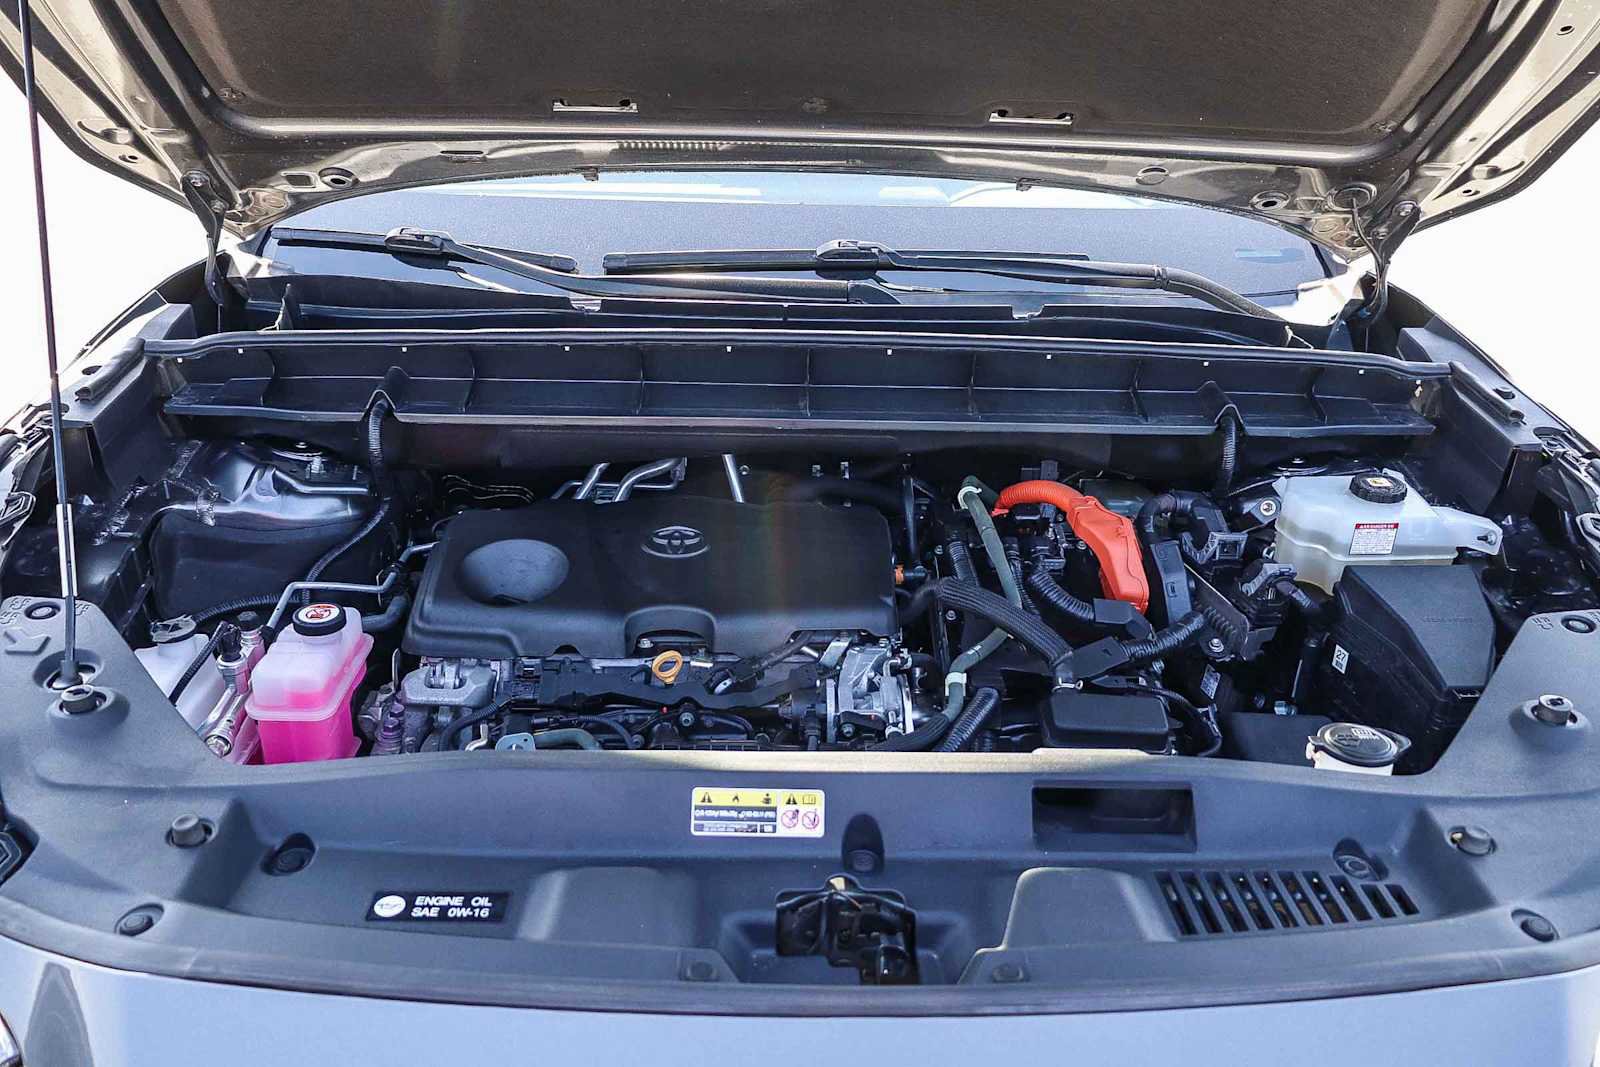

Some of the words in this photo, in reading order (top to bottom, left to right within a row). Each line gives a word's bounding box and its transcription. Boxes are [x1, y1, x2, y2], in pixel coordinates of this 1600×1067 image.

[415, 896, 464, 906] ENGINE
[471, 897, 492, 907] OIL
[411, 907, 439, 917] SAE
[448, 907, 489, 918] 0W-16
